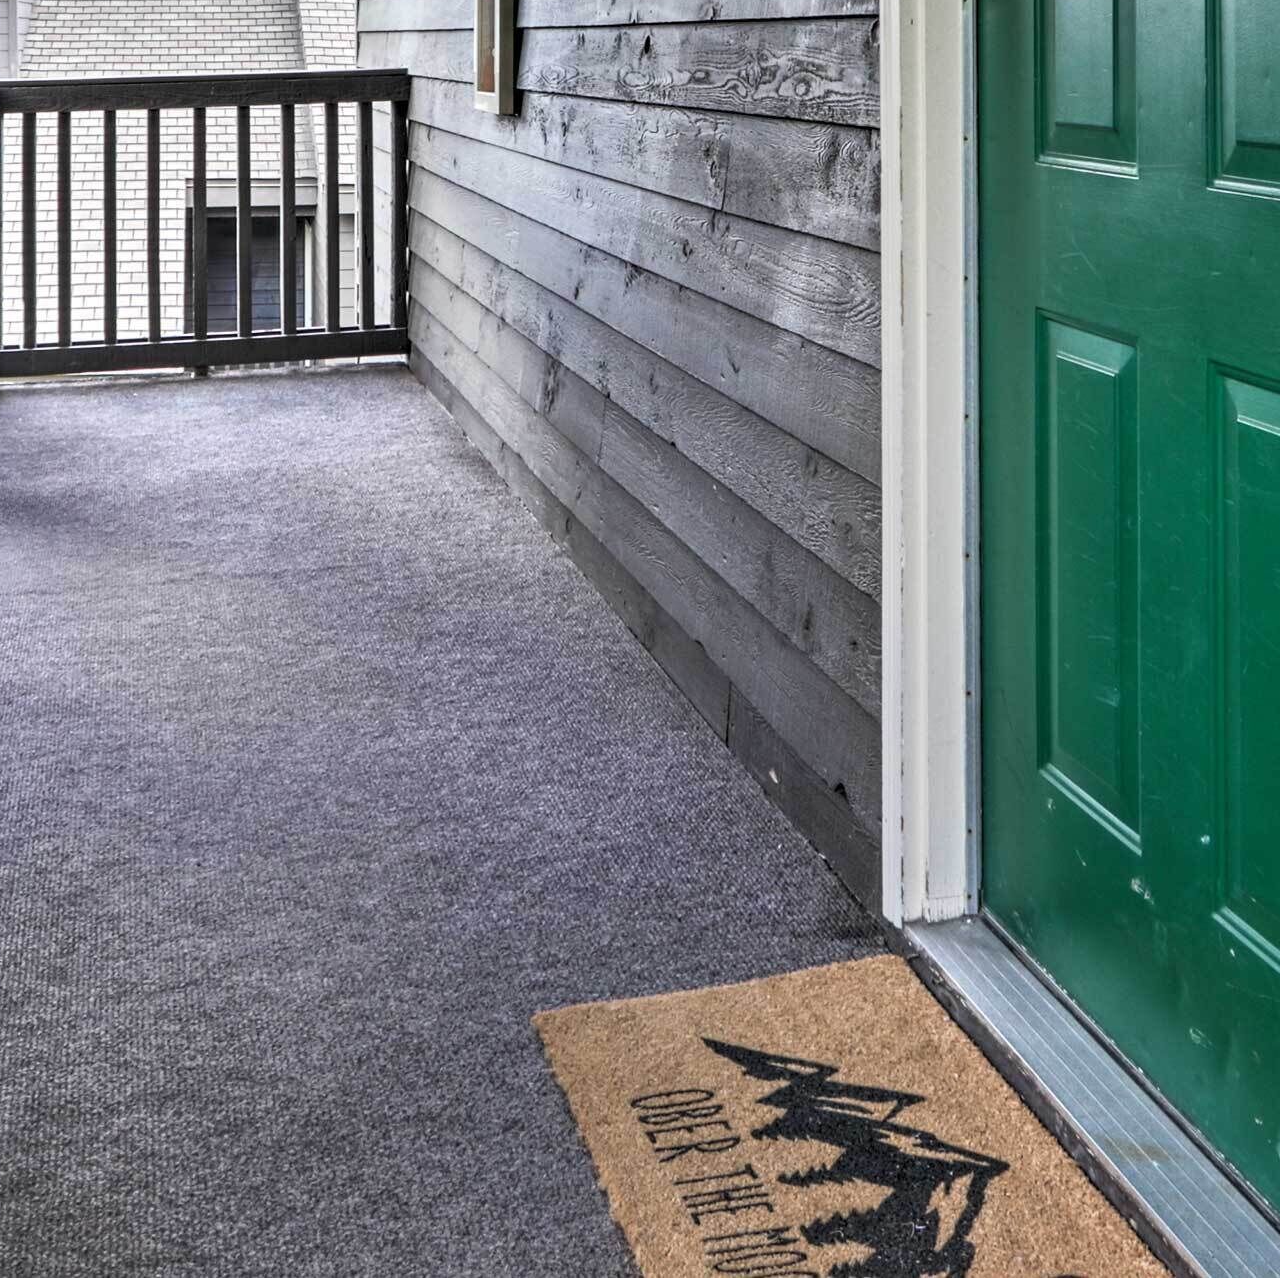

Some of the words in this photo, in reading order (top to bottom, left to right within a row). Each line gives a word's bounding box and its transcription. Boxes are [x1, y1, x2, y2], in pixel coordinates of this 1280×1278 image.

[630, 1089, 741, 1163] OBER
[673, 1163, 774, 1225] THE
[702, 1226, 820, 1278] MO
